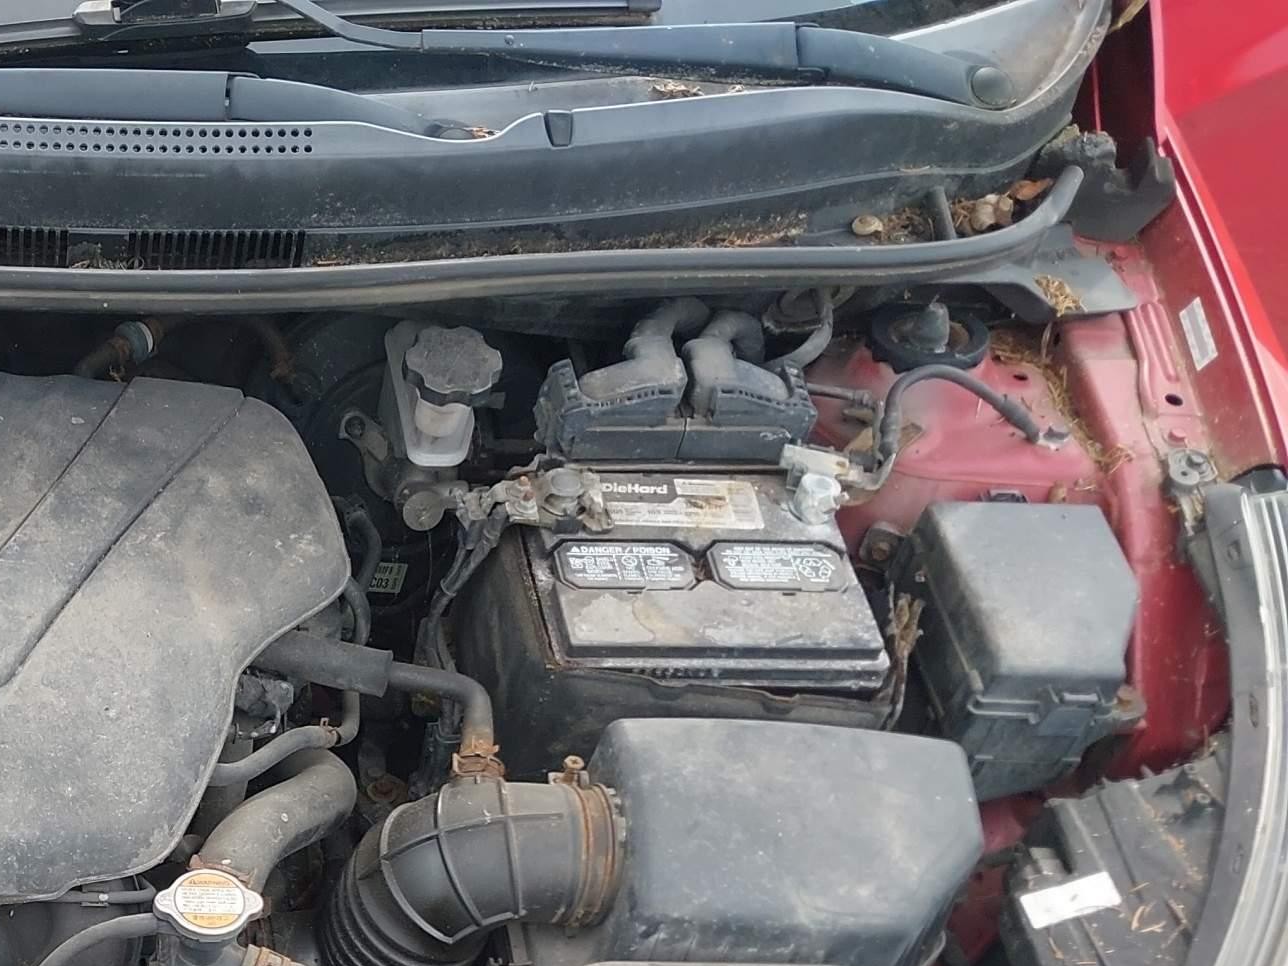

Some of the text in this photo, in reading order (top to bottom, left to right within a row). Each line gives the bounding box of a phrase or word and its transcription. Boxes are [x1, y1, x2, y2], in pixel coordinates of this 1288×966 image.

[601, 482, 669, 495] DieHard
[580, 545, 623, 554] DANGER
[632, 546, 671, 555] POISON
